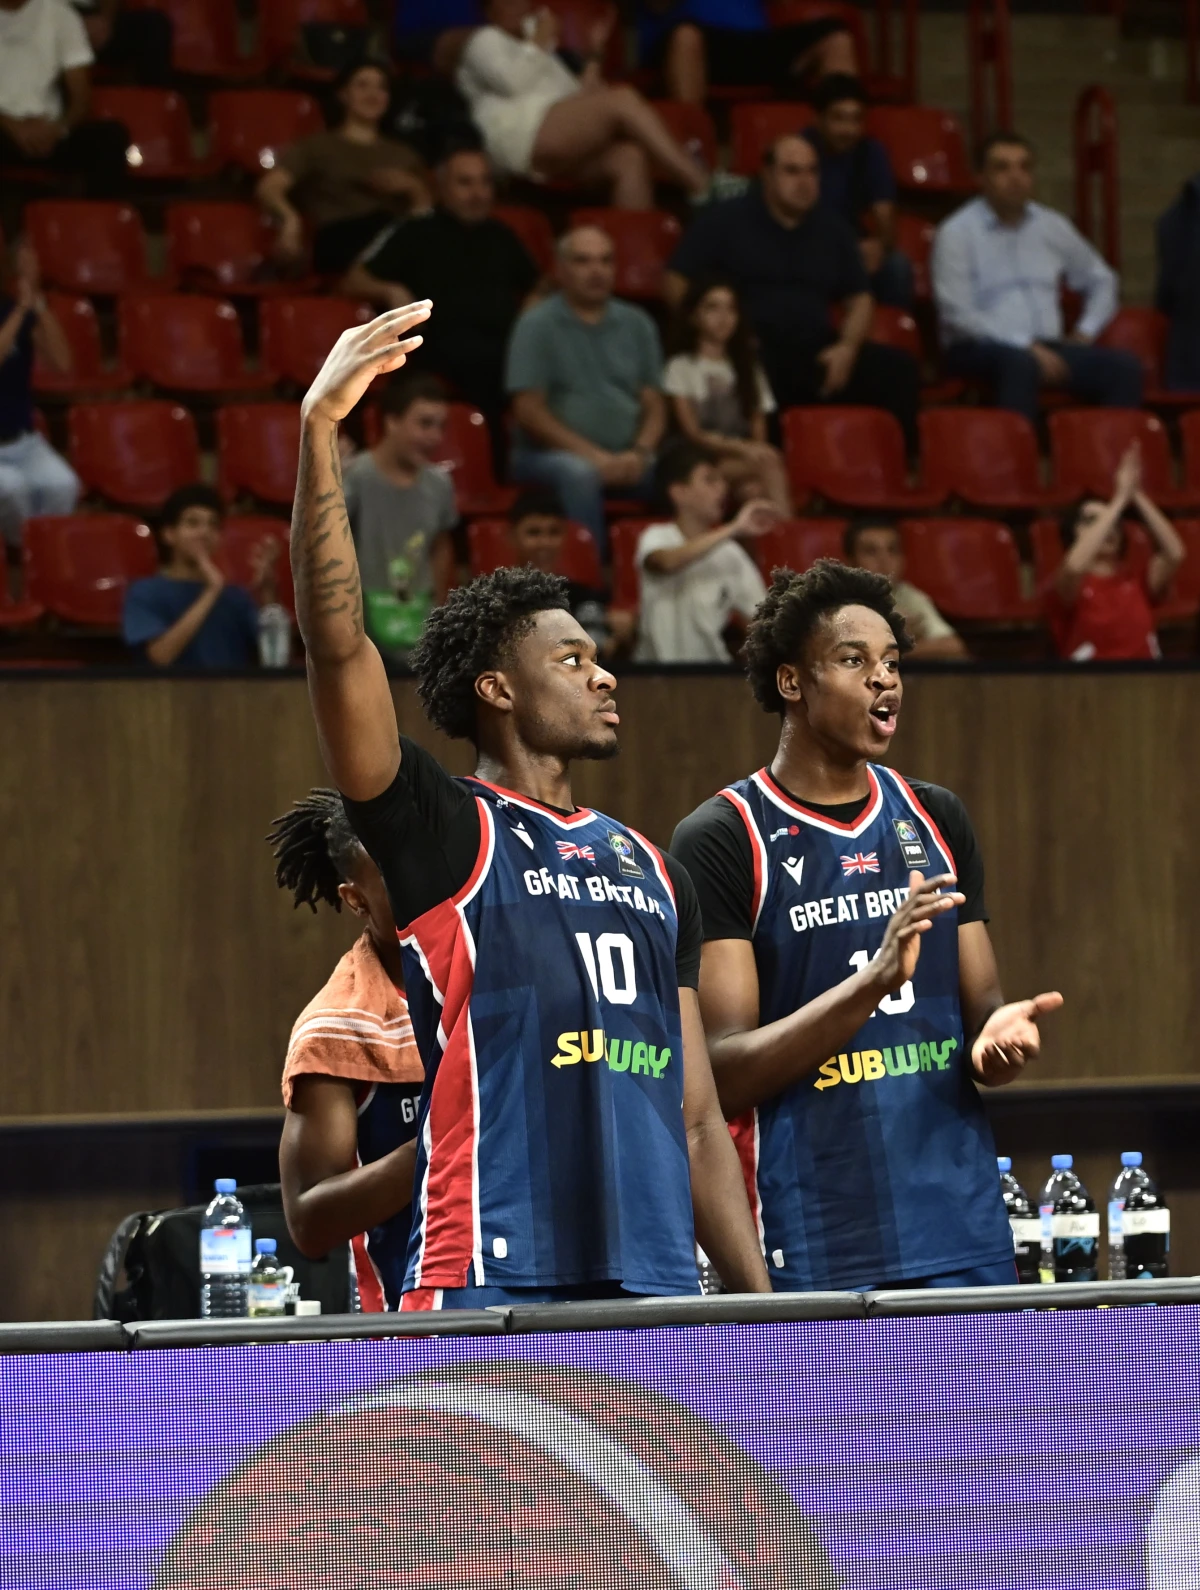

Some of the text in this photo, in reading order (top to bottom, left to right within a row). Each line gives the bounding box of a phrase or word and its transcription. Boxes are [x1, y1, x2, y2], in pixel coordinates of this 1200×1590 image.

[789, 892, 860, 933] GREAT
[574, 932, 638, 1005] 10
[813, 1036, 958, 1092] SUBWAY
